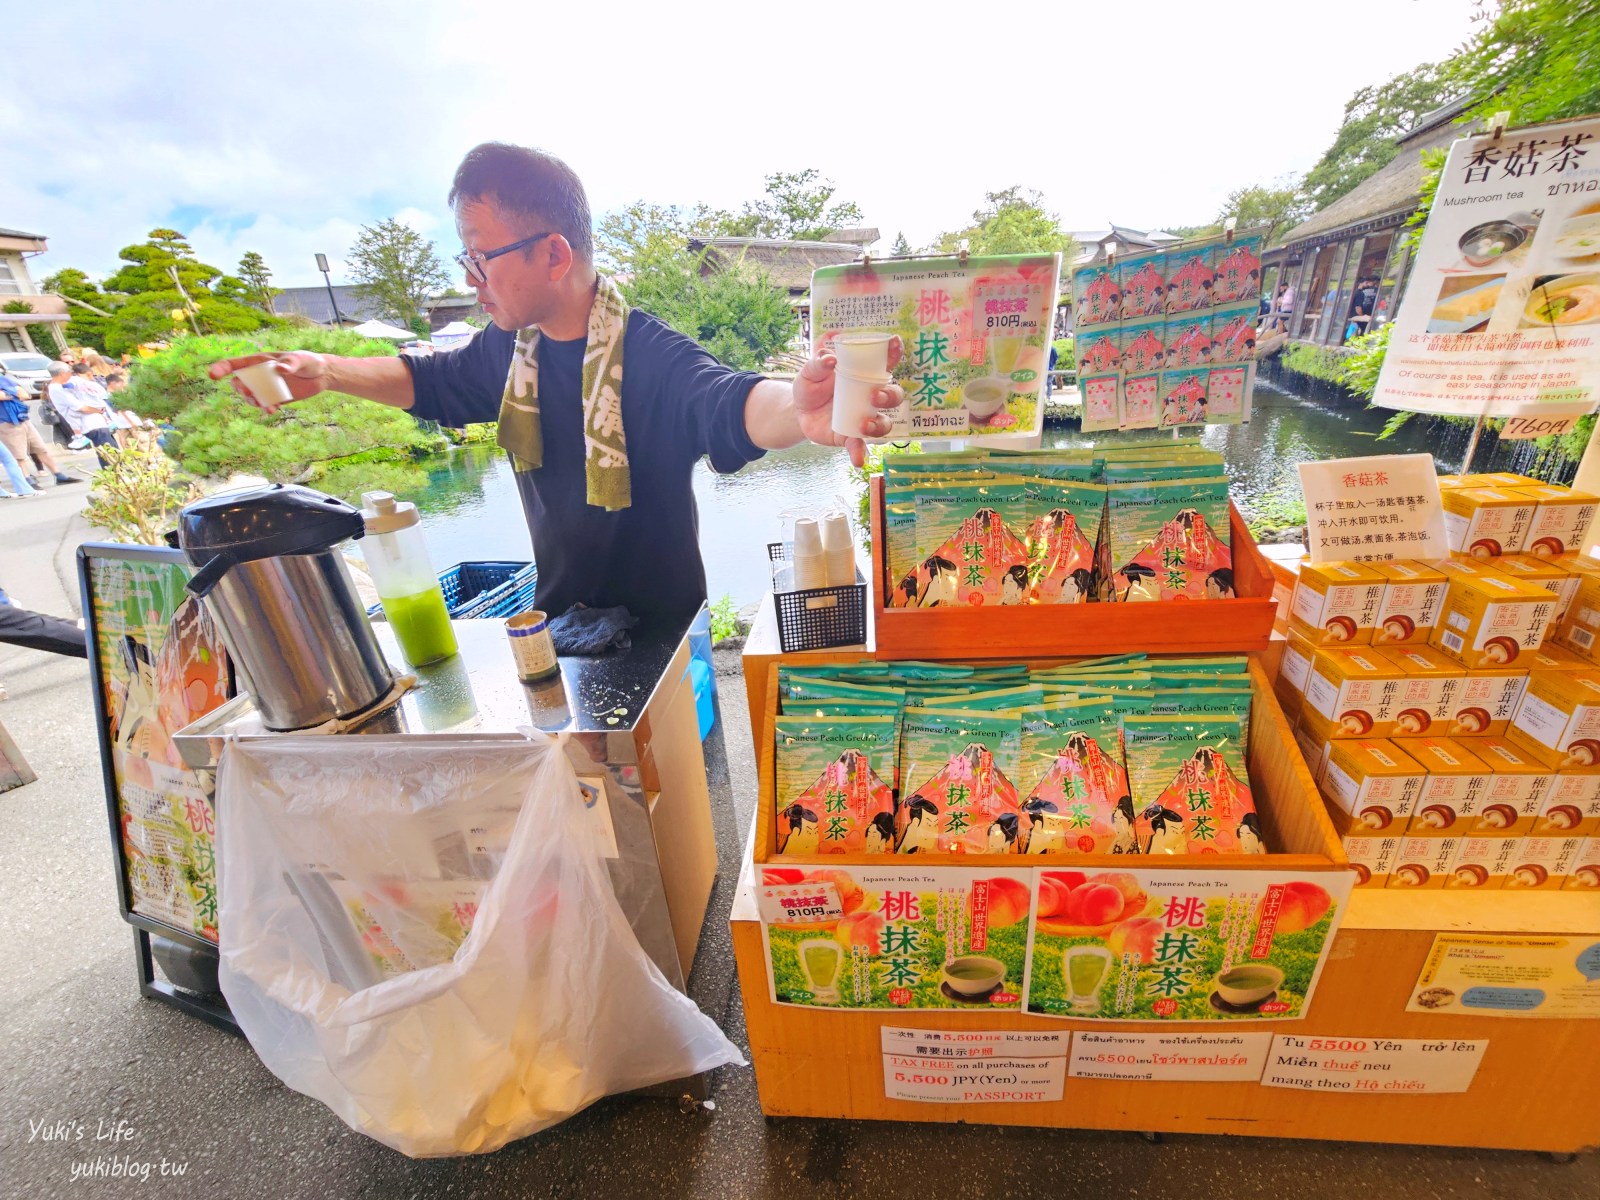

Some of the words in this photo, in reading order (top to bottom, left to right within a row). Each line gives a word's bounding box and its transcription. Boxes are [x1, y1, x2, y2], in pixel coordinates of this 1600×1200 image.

[1461, 133, 1594, 185] 香菇茶
[1443, 193, 1503, 207] Mushroom
[1506, 190, 1524, 200] tea
[892, 273, 925, 282] Japanese
[986, 314, 1020, 328] 810円
[914, 288, 952, 407] 桃抹茶
[1398, 370, 1412, 379] Of
[1413, 372, 1447, 380] course
[1489, 372, 1498, 381] it
[1500, 372, 1509, 380] is
[1511, 371, 1538, 380] used
[1446, 382, 1471, 390] easy
[1473, 381, 1531, 390] seasoning
[1531, 380, 1541, 388] in
[1511, 417, 1570, 435] 760円
[1342, 471, 1389, 488] 香菇茶
[921, 497, 955, 505] Japanese
[1033, 494, 1056, 503] Peach
[1057, 498, 1081, 506] Green
[1116, 500, 1152, 508] Japanese
[1505, 508, 1530, 548] 椎茸茶
[1567, 506, 1593, 547] 椎茸茶
[961, 518, 985, 587] 桃抹茶
[1360, 586, 1380, 624] 椎茸茶
[1417, 585, 1439, 624] 椎茸茶
[1522, 604, 1549, 646] 椎茸茶
[1376, 681, 1399, 719] 椎茸茶
[1493, 678, 1520, 716] 椎茸茶
[1130, 707, 1145, 715] Tea
[1178, 703, 1201, 712] Peach
[1203, 703, 1230, 712] Green
[1231, 703, 1247, 711] Tea
[1069, 717, 1095, 727] Green
[1097, 715, 1111, 723] Tea
[906, 723, 943, 735] Japanese
[971, 729, 997, 737] Green
[1132, 734, 1167, 742] Japanese
[1167, 733, 1193, 741] Peach
[1222, 733, 1237, 741] Tea
[782, 734, 818, 742] Japanese
[820, 734, 844, 742] Peach
[846, 734, 871, 742] Green
[1180, 759, 1215, 841] 桃抹茶
[1395, 777, 1418, 814] 椎茸茶
[1458, 777, 1484, 815] 椎茸茶
[1520, 776, 1549, 814] 椎茸茶
[787, 907, 825, 917] 810円
[972, 882, 989, 949] 富士山世界遺産
[1254, 887, 1283, 957] 富士山世界遺産
[878, 890, 921, 987] 桃抹茶
[1147, 896, 1207, 996] 桃抹茶
[789, 991, 812, 999] アイス
[1044, 1000, 1069, 1009] アイス
[889, 1031, 915, 1039] 一次性
[915, 1046, 994, 1057] 需要出示护照
[1282, 1037, 1304, 1048] Tu
[1308, 1039, 1367, 1051] 5500
[1372, 1041, 1402, 1051] Yên
[1452, 1041, 1476, 1052] lên
[890, 1057, 918, 1067] TAX
[921, 1059, 954, 1069] FREE
[972, 1061, 983, 1069] all
[986, 1061, 1036, 1072] purchases
[1038, 1061, 1050, 1069] of
[1363, 1062, 1391, 1071] neu
[951, 1074, 1018, 1086] JPY(Yen)
[1271, 1075, 1312, 1088] mang
[1317, 1077, 1350, 1089] theo
[964, 1091, 1045, 1101] PASSPORT
